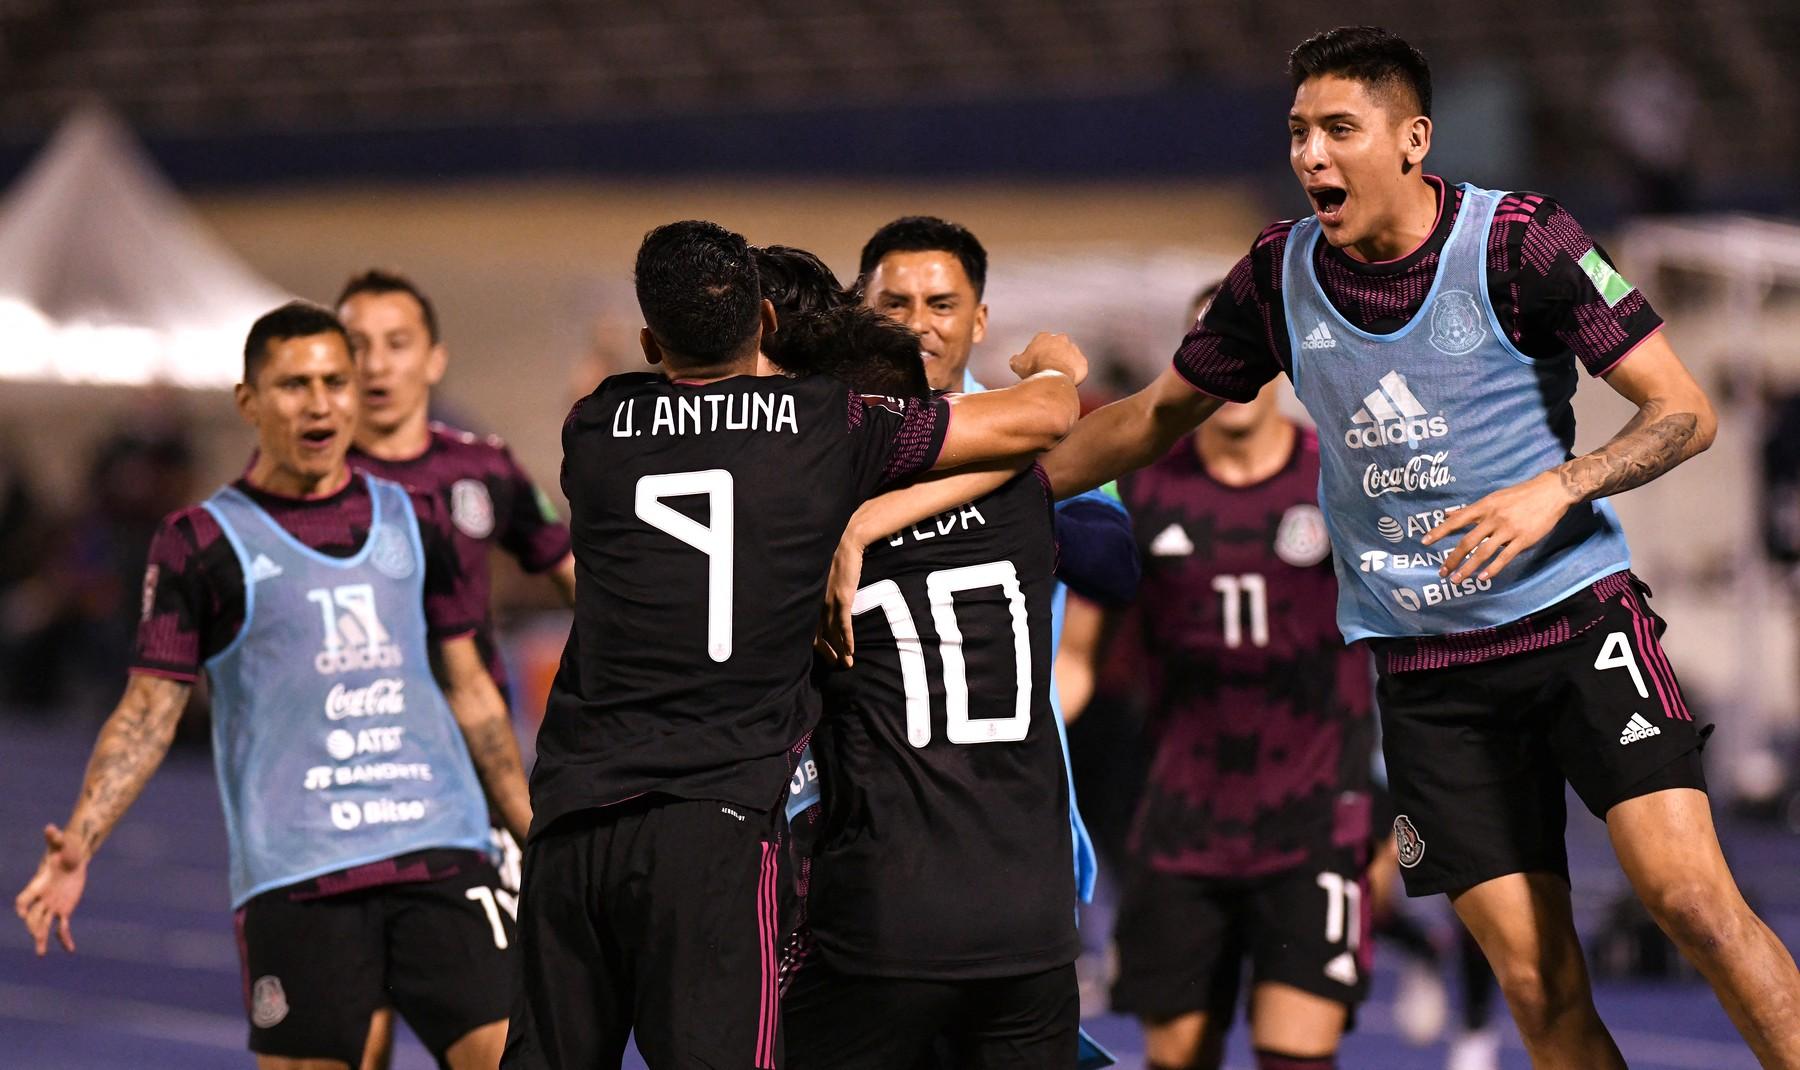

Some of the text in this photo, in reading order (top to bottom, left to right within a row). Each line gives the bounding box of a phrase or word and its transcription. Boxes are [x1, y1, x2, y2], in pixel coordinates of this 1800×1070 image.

[1301, 338, 1337, 350] adidas
[612, 391, 799, 438] U. ANTUNA
[1344, 411, 1449, 449] adidas
[1407, 504, 1467, 538] AT&
[635, 469, 734, 663] 9
[1211, 573, 1269, 649] 11
[1422, 578, 1492, 606] Bitso
[851, 560, 1032, 749] 10
[1594, 631, 1650, 699] 4
[1619, 726, 1661, 745] adidas
[1316, 871, 1362, 951] 11
